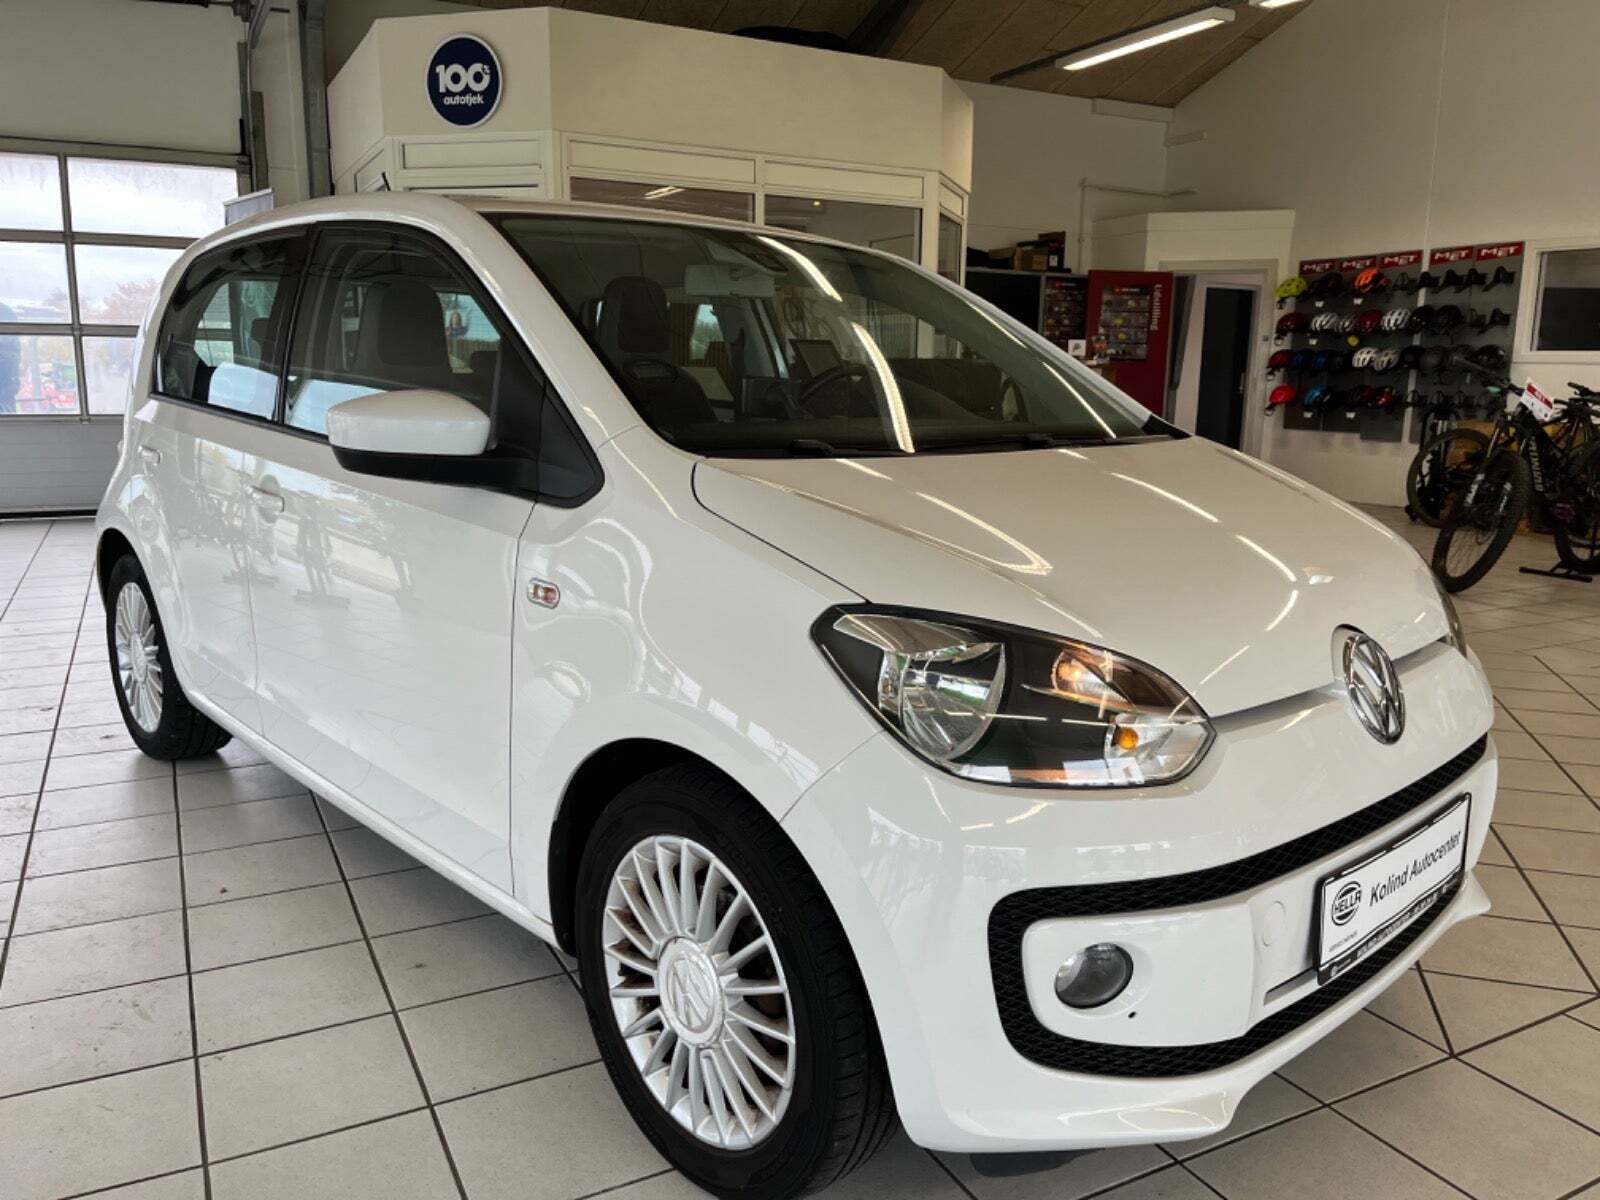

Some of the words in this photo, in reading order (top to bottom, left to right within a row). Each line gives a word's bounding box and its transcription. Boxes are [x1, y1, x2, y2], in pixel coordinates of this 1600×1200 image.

[443, 93, 484, 106] autotjek
[1433, 250, 1470, 262] MET
[1480, 246, 1518, 258] MET
[1342, 259, 1374, 270] MET
[1383, 254, 1418, 266] MET
[1303, 262, 1332, 273] MET
[1369, 865, 1410, 906] Kolind
[1409, 831, 1462, 880] Autocenter
